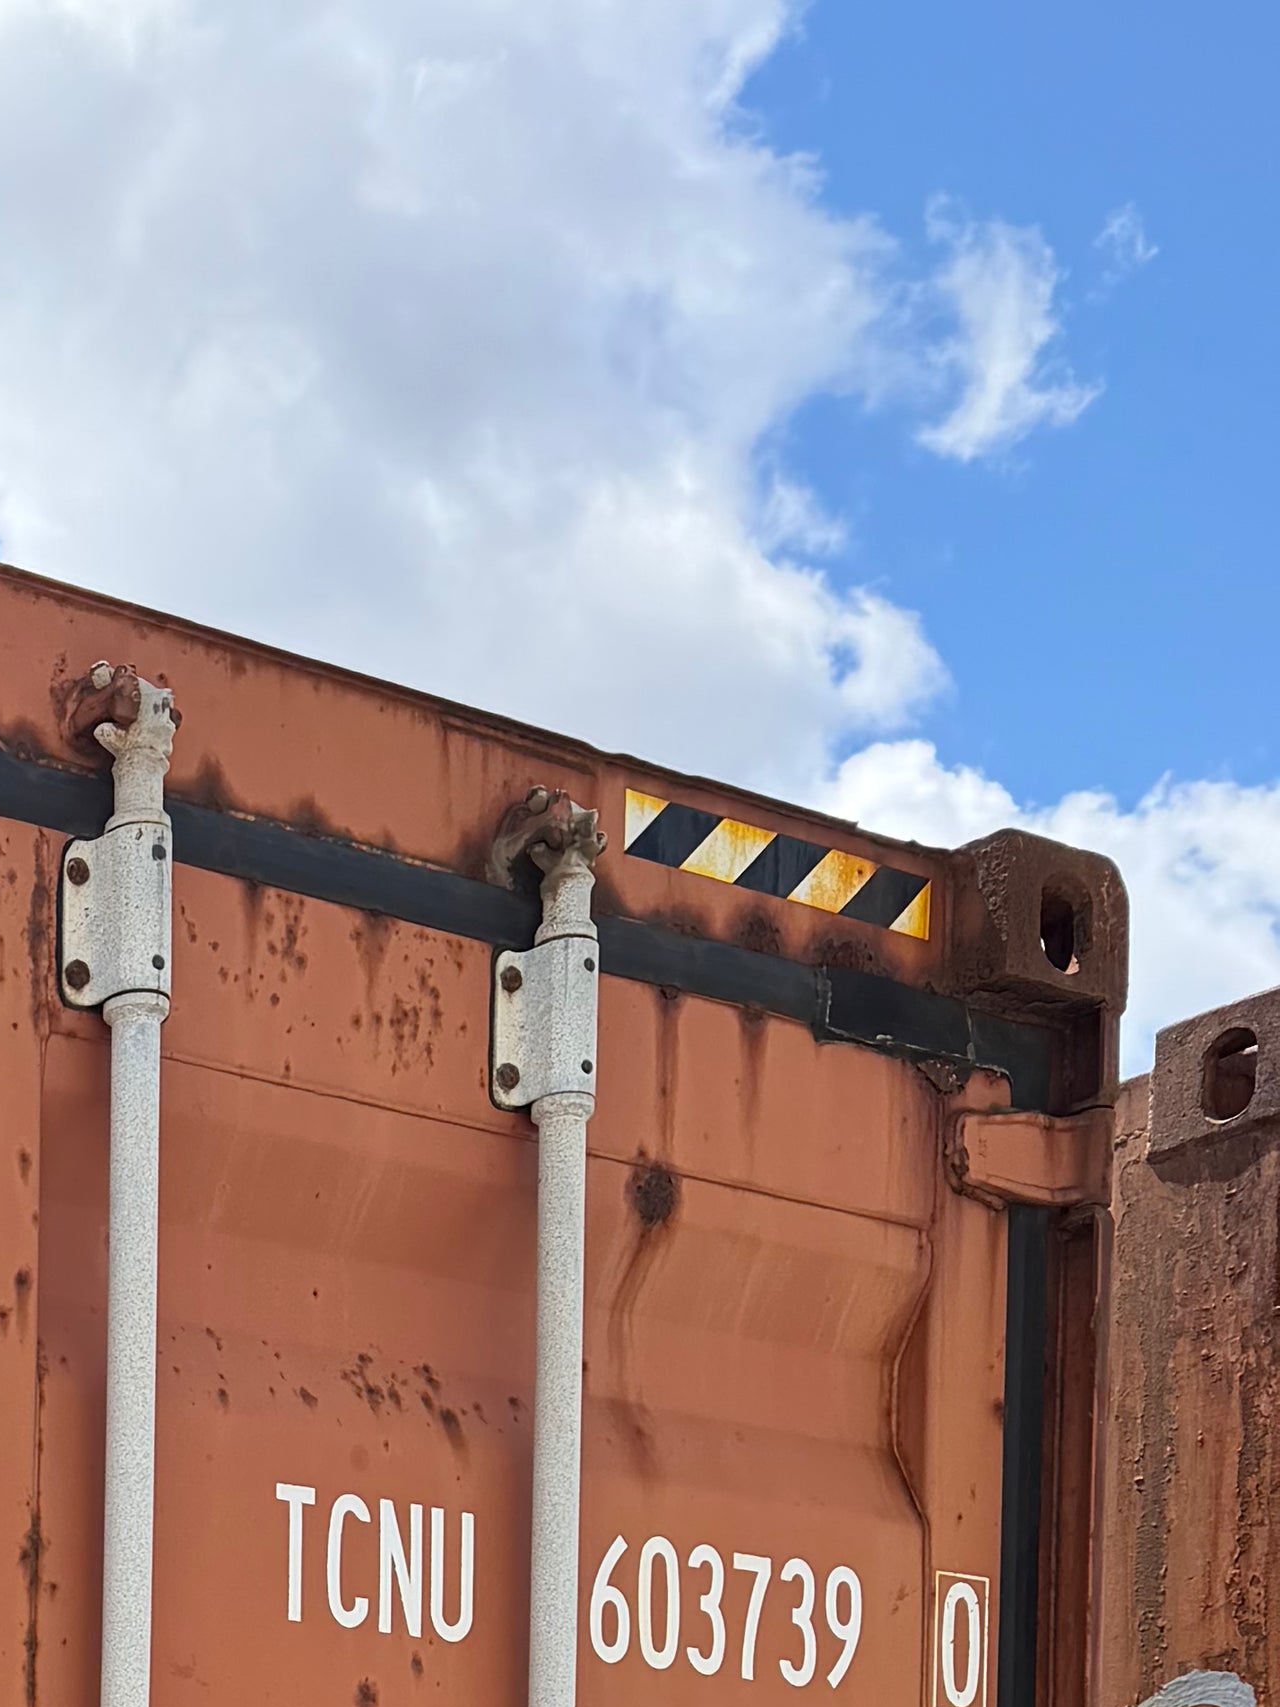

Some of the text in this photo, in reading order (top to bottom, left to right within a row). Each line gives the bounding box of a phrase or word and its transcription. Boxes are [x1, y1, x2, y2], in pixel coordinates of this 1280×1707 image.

[274, 1481, 981, 1707] TCNU 603739 0
